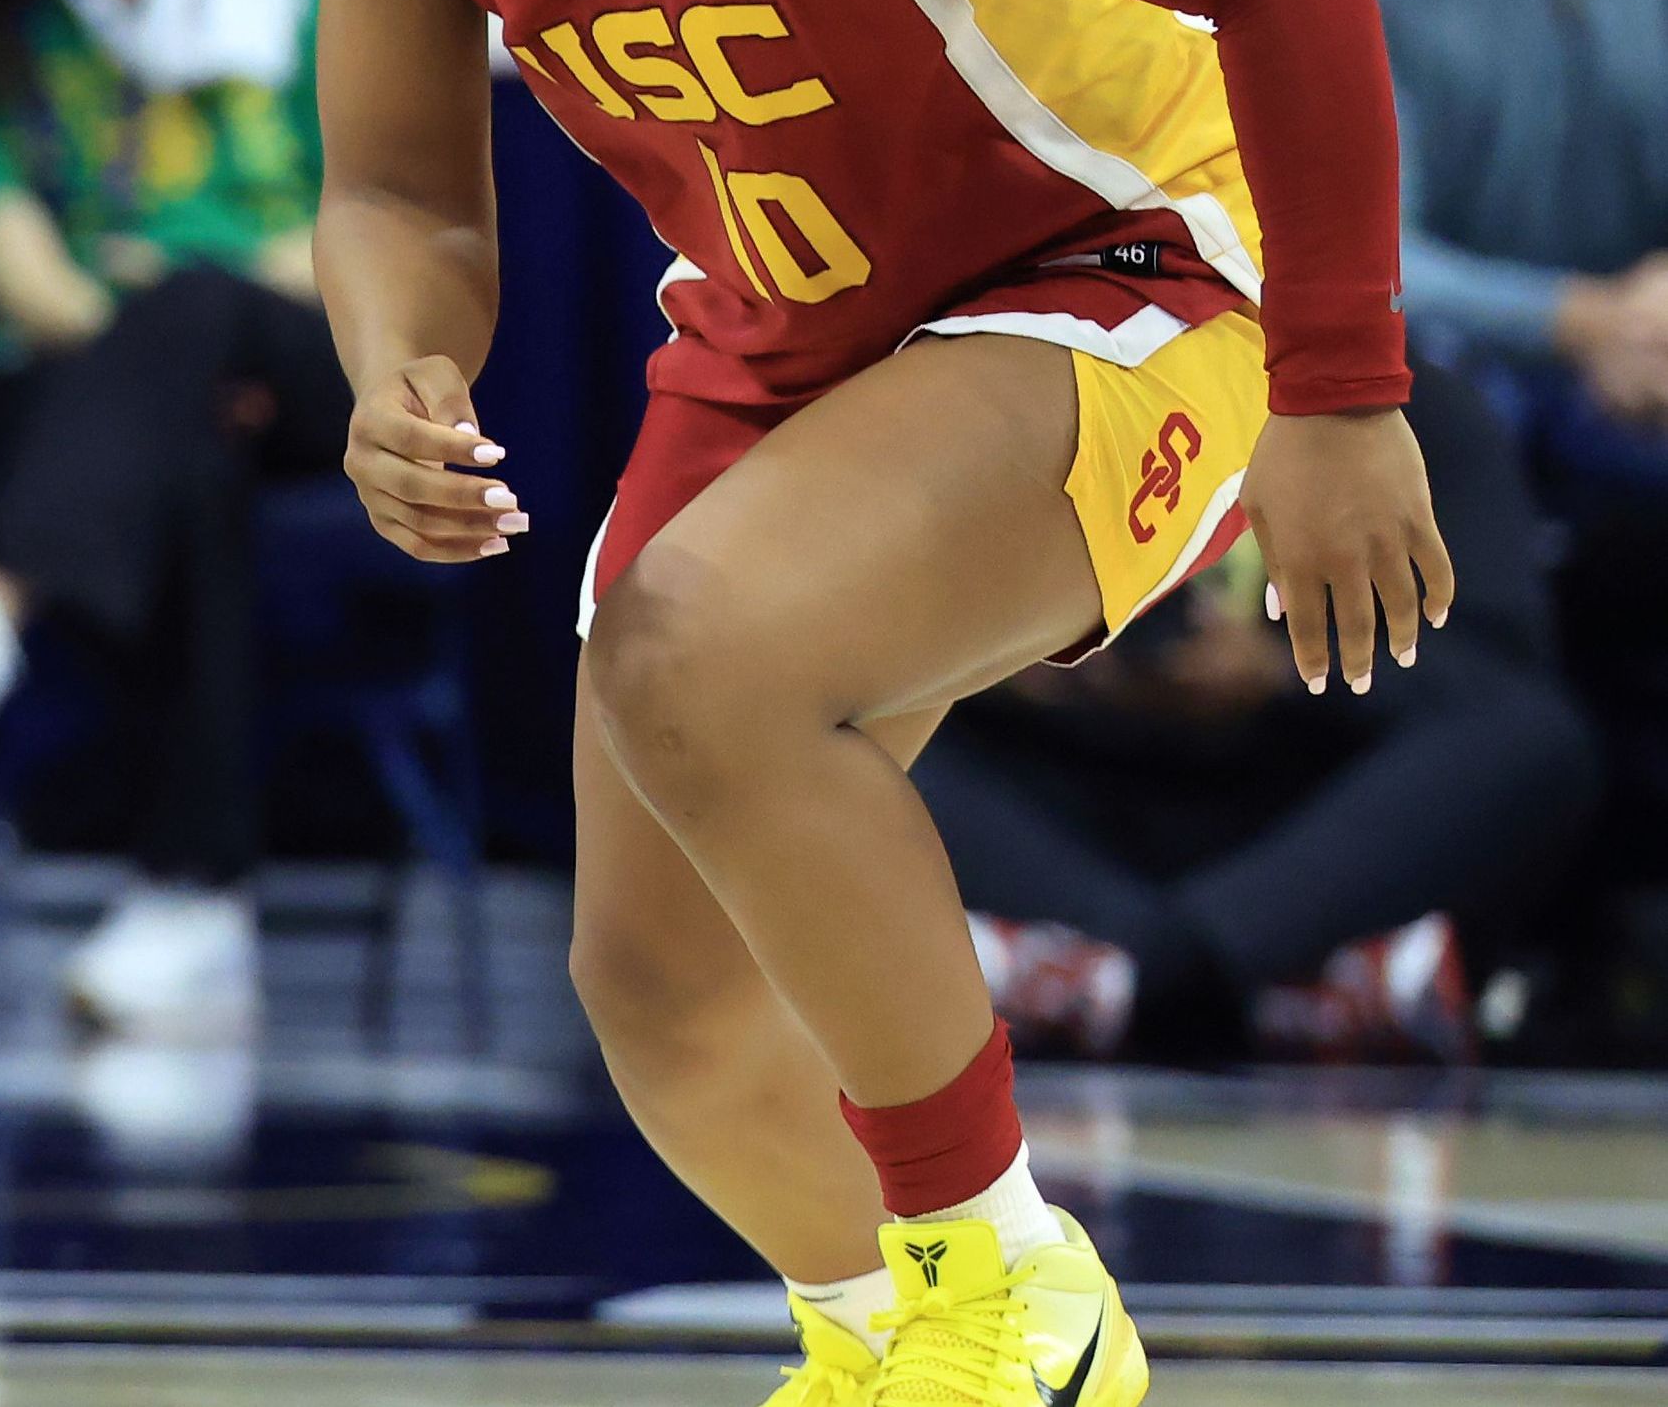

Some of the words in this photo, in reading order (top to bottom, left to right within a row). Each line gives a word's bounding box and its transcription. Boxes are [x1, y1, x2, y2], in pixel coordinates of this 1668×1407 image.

[509, 4, 836, 126] USC
[696, 138, 873, 305] 10
[1114, 243, 1146, 265] 46
